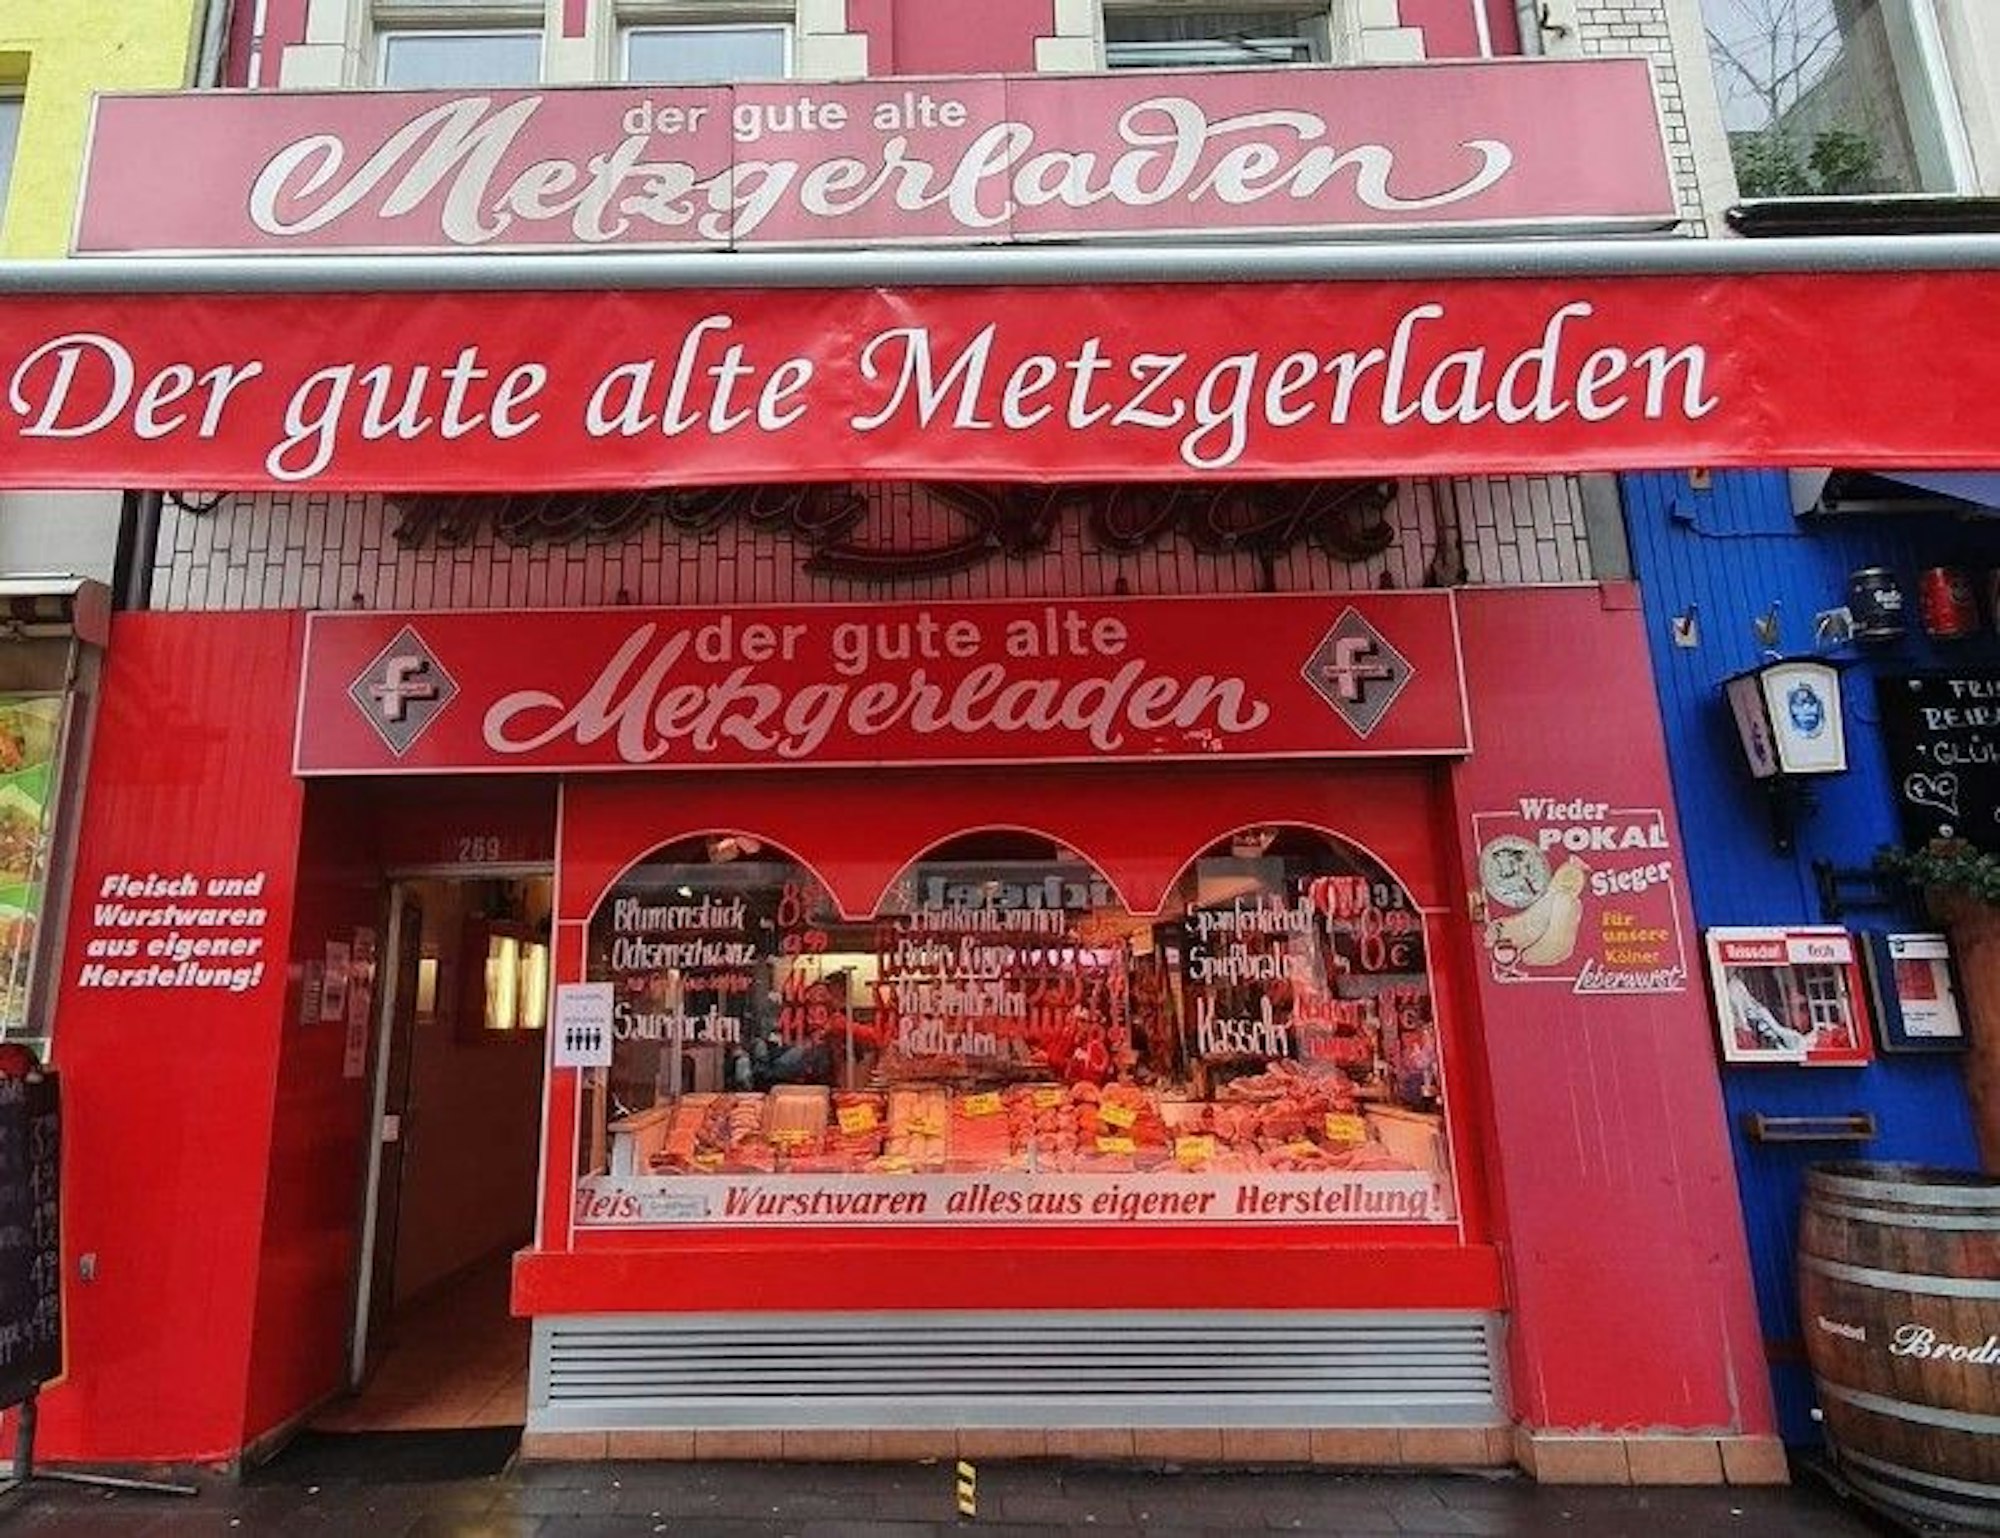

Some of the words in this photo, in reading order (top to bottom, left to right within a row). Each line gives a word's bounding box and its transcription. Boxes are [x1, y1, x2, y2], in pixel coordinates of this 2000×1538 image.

[623, 99, 706, 138] der
[733, 100, 848, 139] gute
[872, 93, 968, 131] alte
[248, 95, 1512, 245] Metzgerladen
[8, 333, 263, 439] Der
[264, 345, 547, 482] gute
[585, 316, 814, 435] alte
[850, 301, 1718, 470] Metzgerladen
[695, 615, 807, 663] der
[832, 612, 981, 675] gute
[1006, 607, 1128, 657] alte
[482, 622, 1269, 762] Metzgerladen
[1520, 798, 1609, 821] Wieder
[1538, 825, 1669, 850] POKAL
[101, 872, 199, 898] Fleisch
[207, 871, 265, 896] und
[1590, 861, 1672, 896] Sieger
[94, 903, 267, 926] Wurstwaren
[614, 895, 747, 932] Blumenstück
[87, 938, 139, 957] aus
[147, 931, 262, 961] eigener
[612, 935, 757, 970] Ochsenschwanz
[1603, 928, 1669, 942] unsere
[78, 961, 265, 992] Herstellung!
[724, 1186, 926, 1217] Wurstwaren
[1028, 1189, 1083, 1214] aus
[1091, 1183, 1216, 1221] eigener
[1235, 1182, 1442, 1219] Herstellung!
